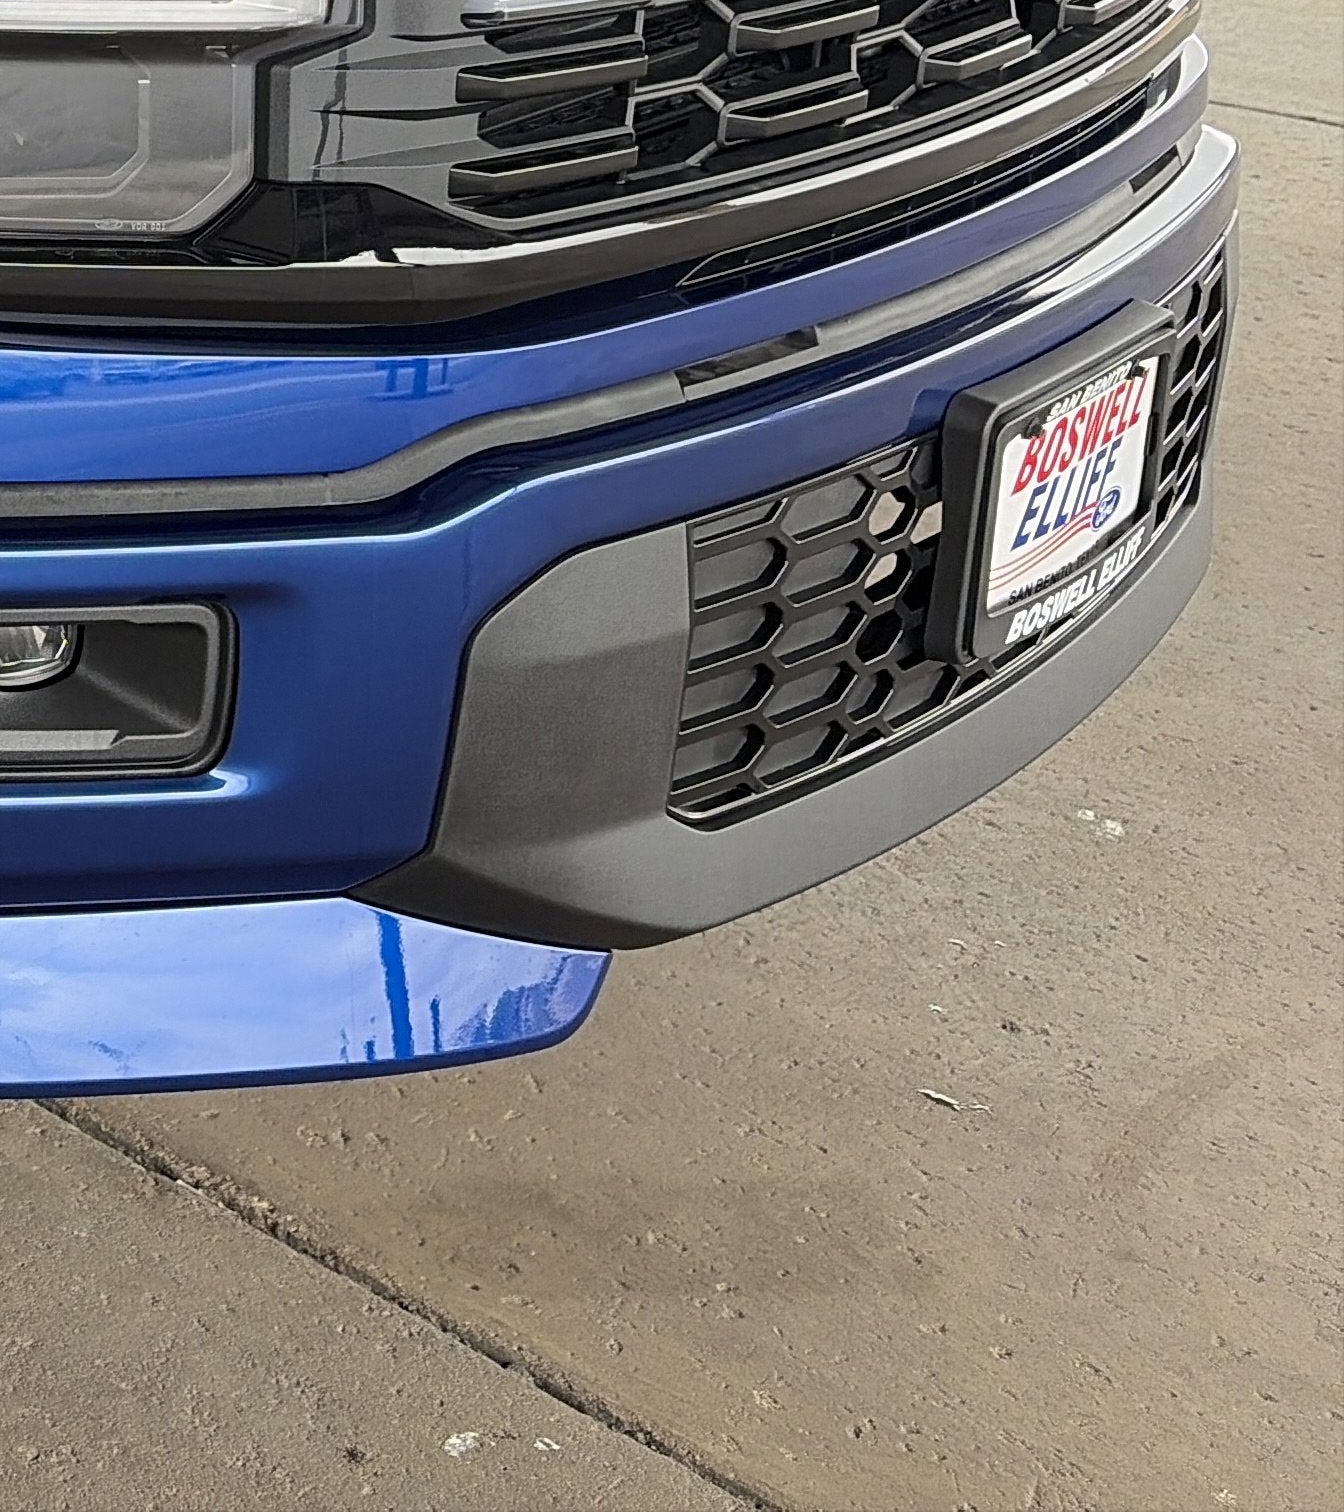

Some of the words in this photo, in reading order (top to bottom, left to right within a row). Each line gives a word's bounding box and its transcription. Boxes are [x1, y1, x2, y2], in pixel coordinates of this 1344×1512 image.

[1011, 368, 1150, 496] BOSWELL
[1046, 389, 1083, 422] SAN
[1011, 435, 1124, 551] ELLIFF
[1004, 569, 1097, 644] BOSWELL
[1096, 526, 1146, 589] ELLIFF
[1008, 584, 1033, 606] SAN
